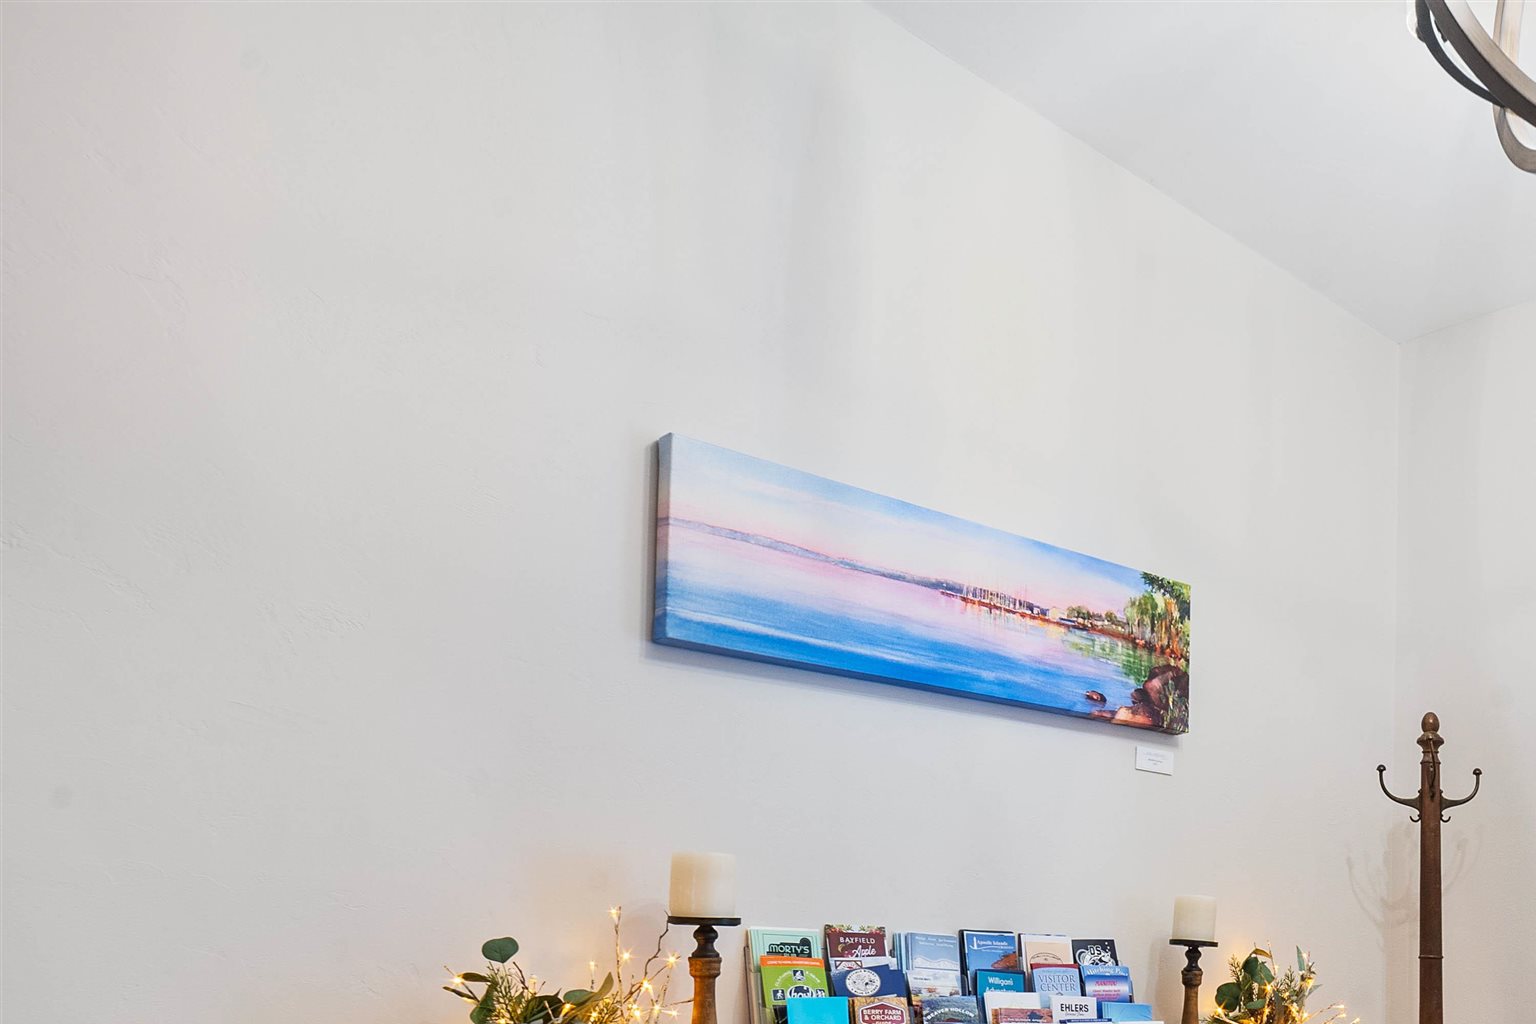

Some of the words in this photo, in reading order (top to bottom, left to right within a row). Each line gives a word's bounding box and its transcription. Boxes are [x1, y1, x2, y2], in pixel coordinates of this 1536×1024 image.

[840, 936, 876, 944] BAYFIELD
[769, 944, 810, 954] MORTY'S
[848, 944, 877, 958] Apple
[1038, 974, 1076, 983] VISITOR
[1040, 983, 1077, 992] CENTER
[1060, 1003, 1089, 1013] EHLERS
[926, 1007, 949, 1020] BEAVER
[949, 1007, 975, 1018] HOLLOW
